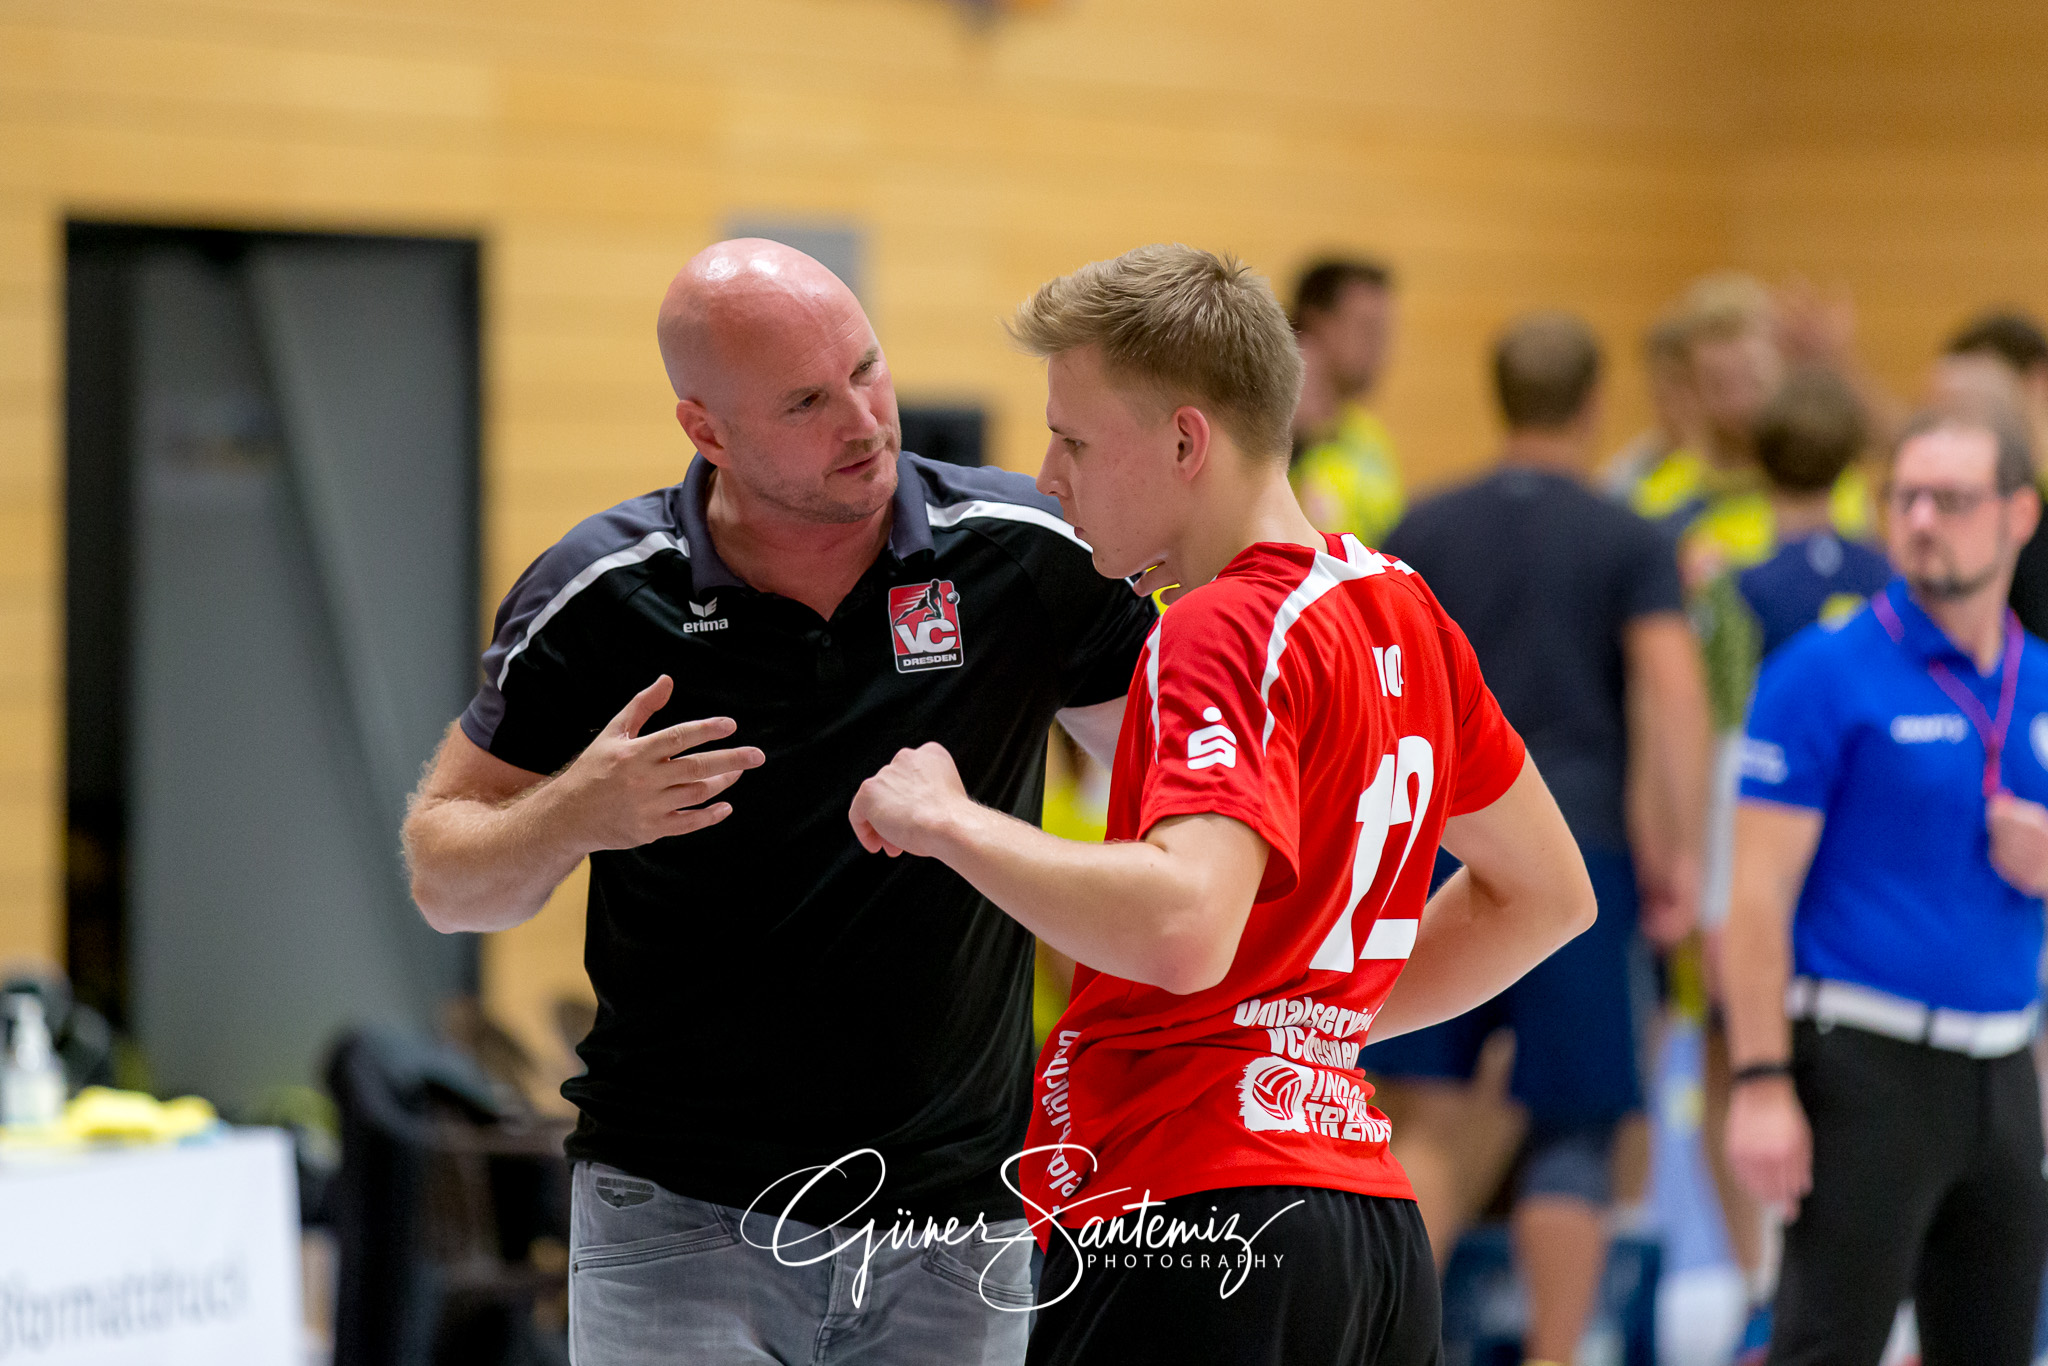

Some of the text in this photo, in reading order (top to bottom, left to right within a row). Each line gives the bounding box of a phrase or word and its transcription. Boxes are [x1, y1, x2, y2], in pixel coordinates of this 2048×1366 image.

[683, 618, 729, 633] erima
[895, 619, 957, 654] VC
[903, 653, 957, 667] DRESDEN
[1309, 736, 1434, 973] 12
